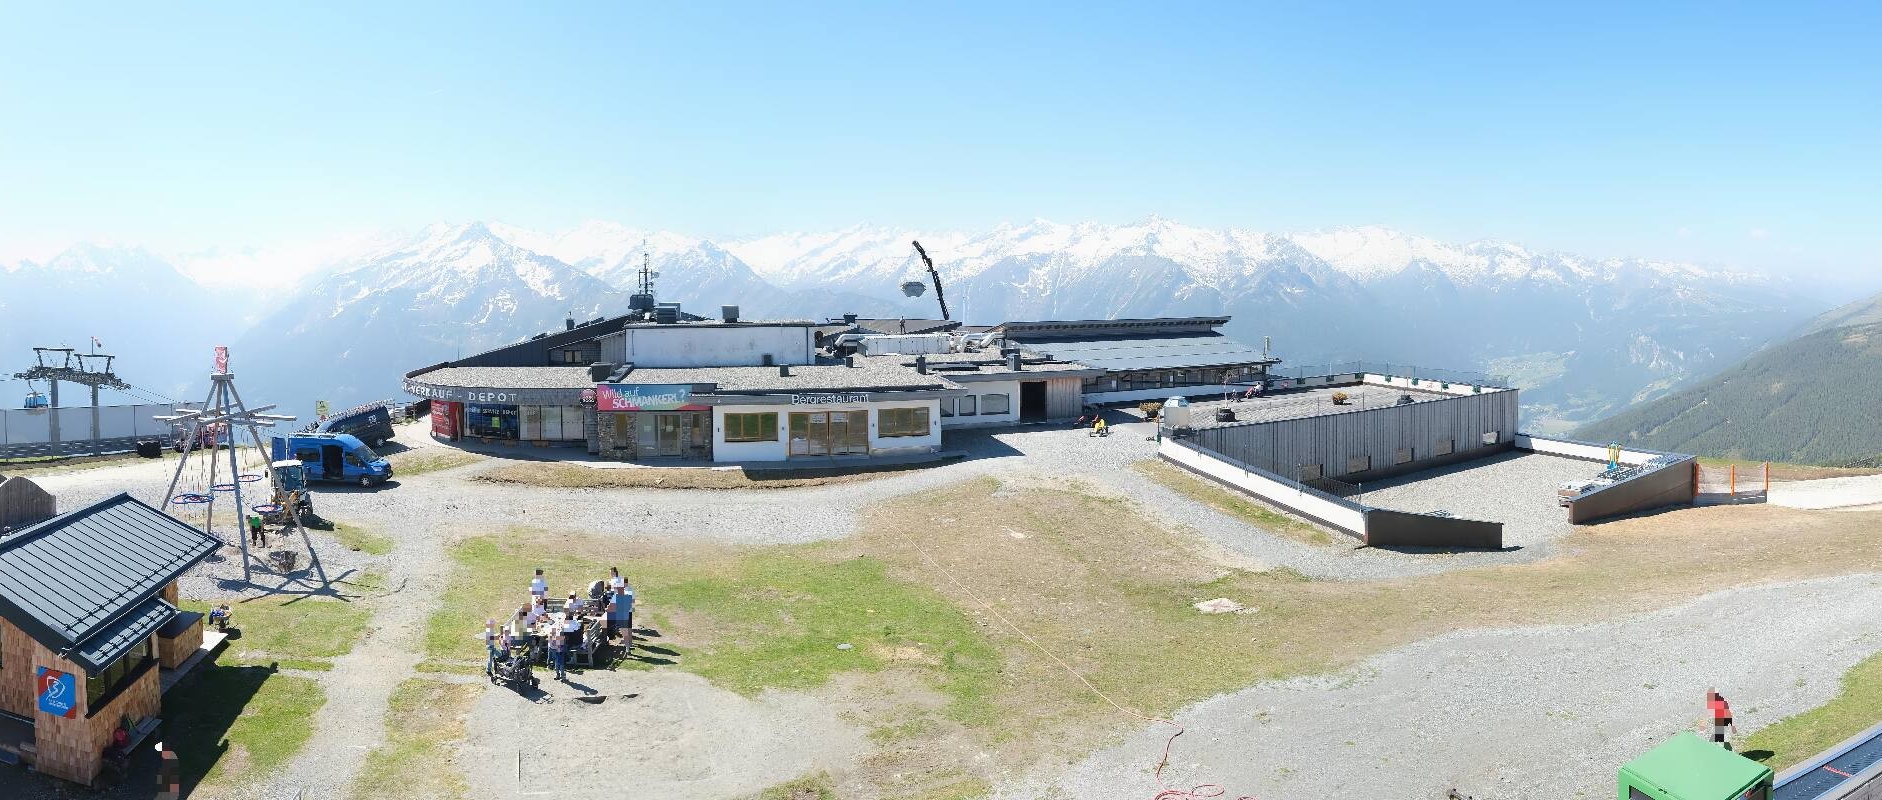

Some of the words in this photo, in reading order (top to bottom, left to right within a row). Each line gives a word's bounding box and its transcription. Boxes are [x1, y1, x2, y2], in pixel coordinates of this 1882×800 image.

[468, 391, 518, 402] DEPOT
[601, 388, 623, 400] Wild
[624, 386, 640, 398] auf
[612, 388, 686, 409] SCHMANKERL?
[791, 394, 869, 405] Bergrestaurant
